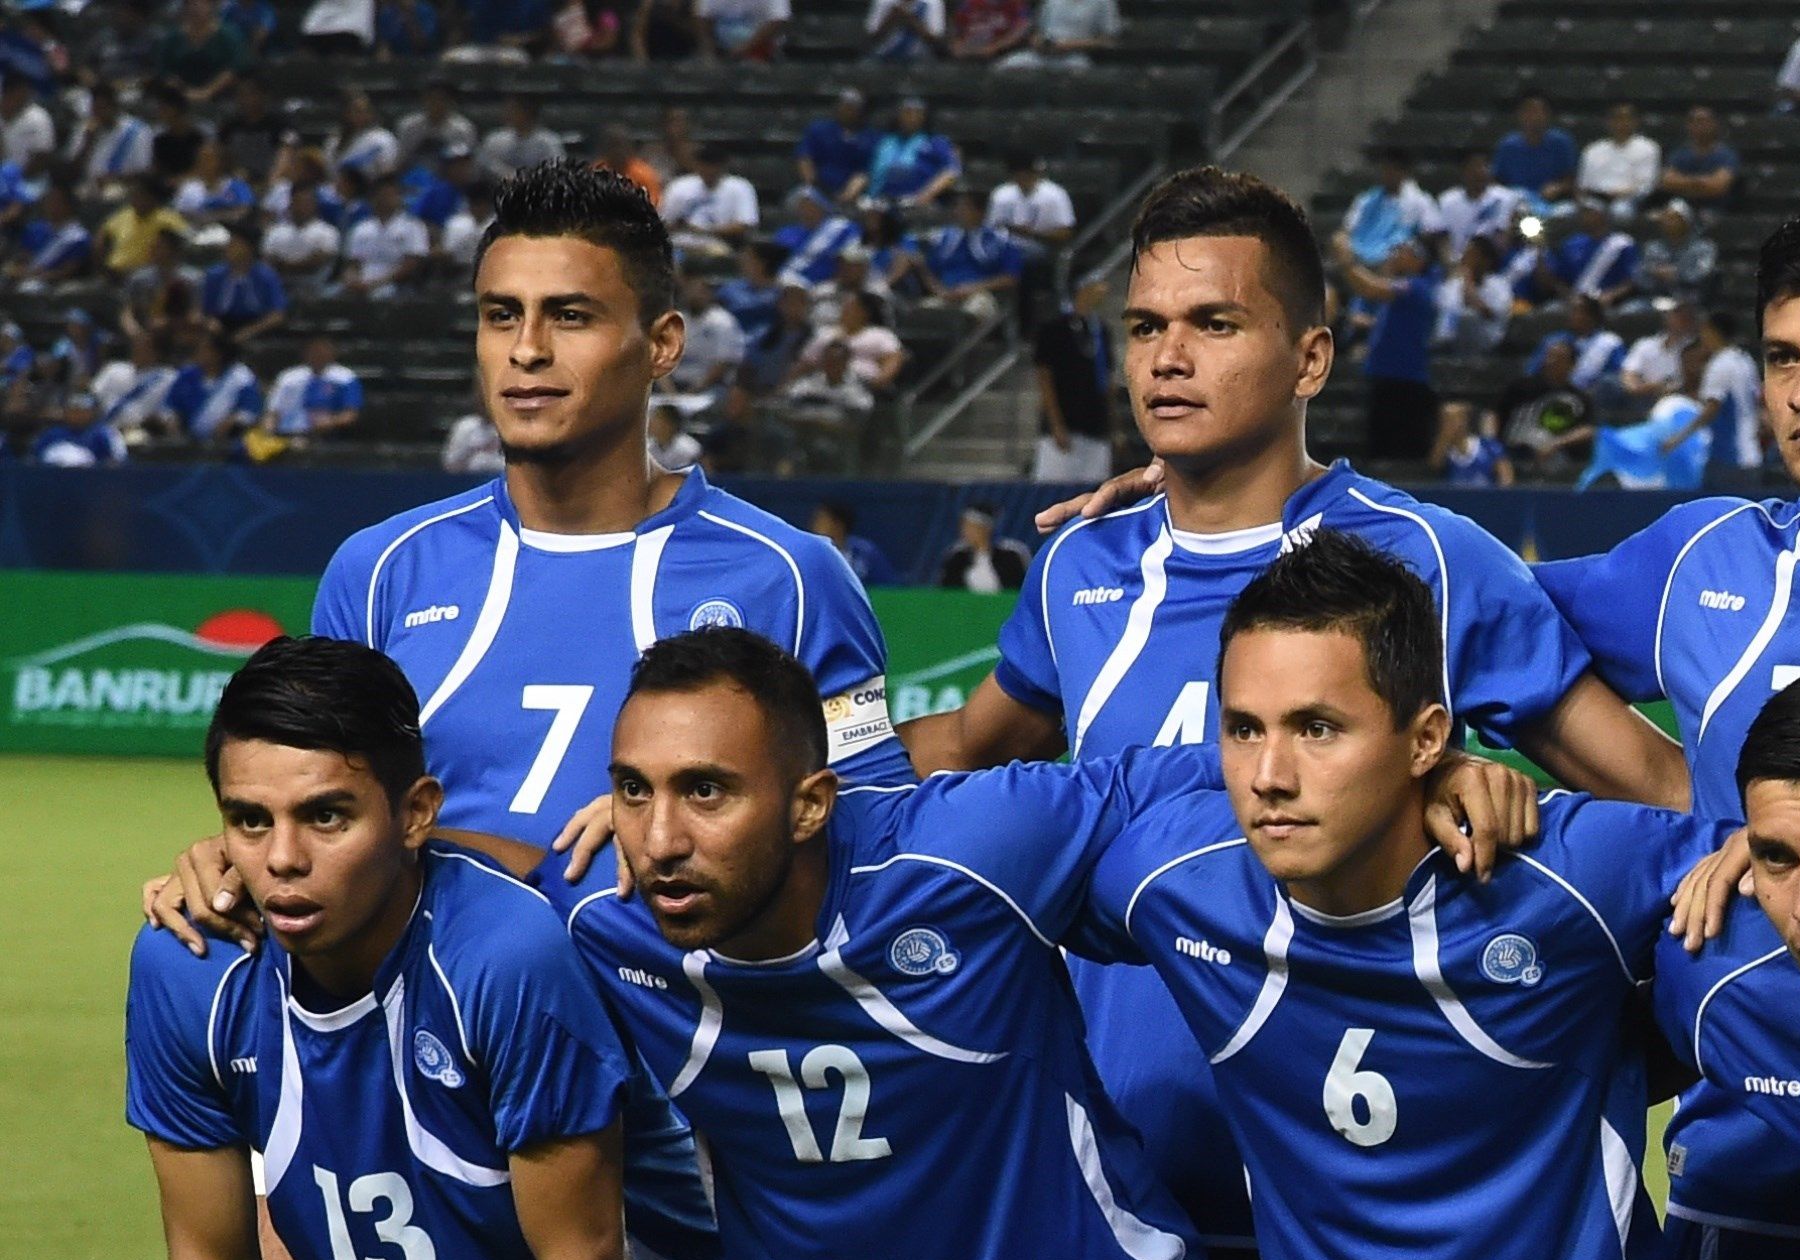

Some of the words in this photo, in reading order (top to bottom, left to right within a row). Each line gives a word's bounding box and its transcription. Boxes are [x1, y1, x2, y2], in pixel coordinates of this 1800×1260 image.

[1072, 586, 1124, 606] mitre
[1698, 589, 1746, 611] mitre
[403, 605, 460, 628] mitre
[508, 684, 595, 815] 7
[1175, 936, 1232, 966] mitre
[618, 967, 668, 990] mitre
[1322, 1027, 1398, 1148] 6
[747, 1043, 894, 1161] 12
